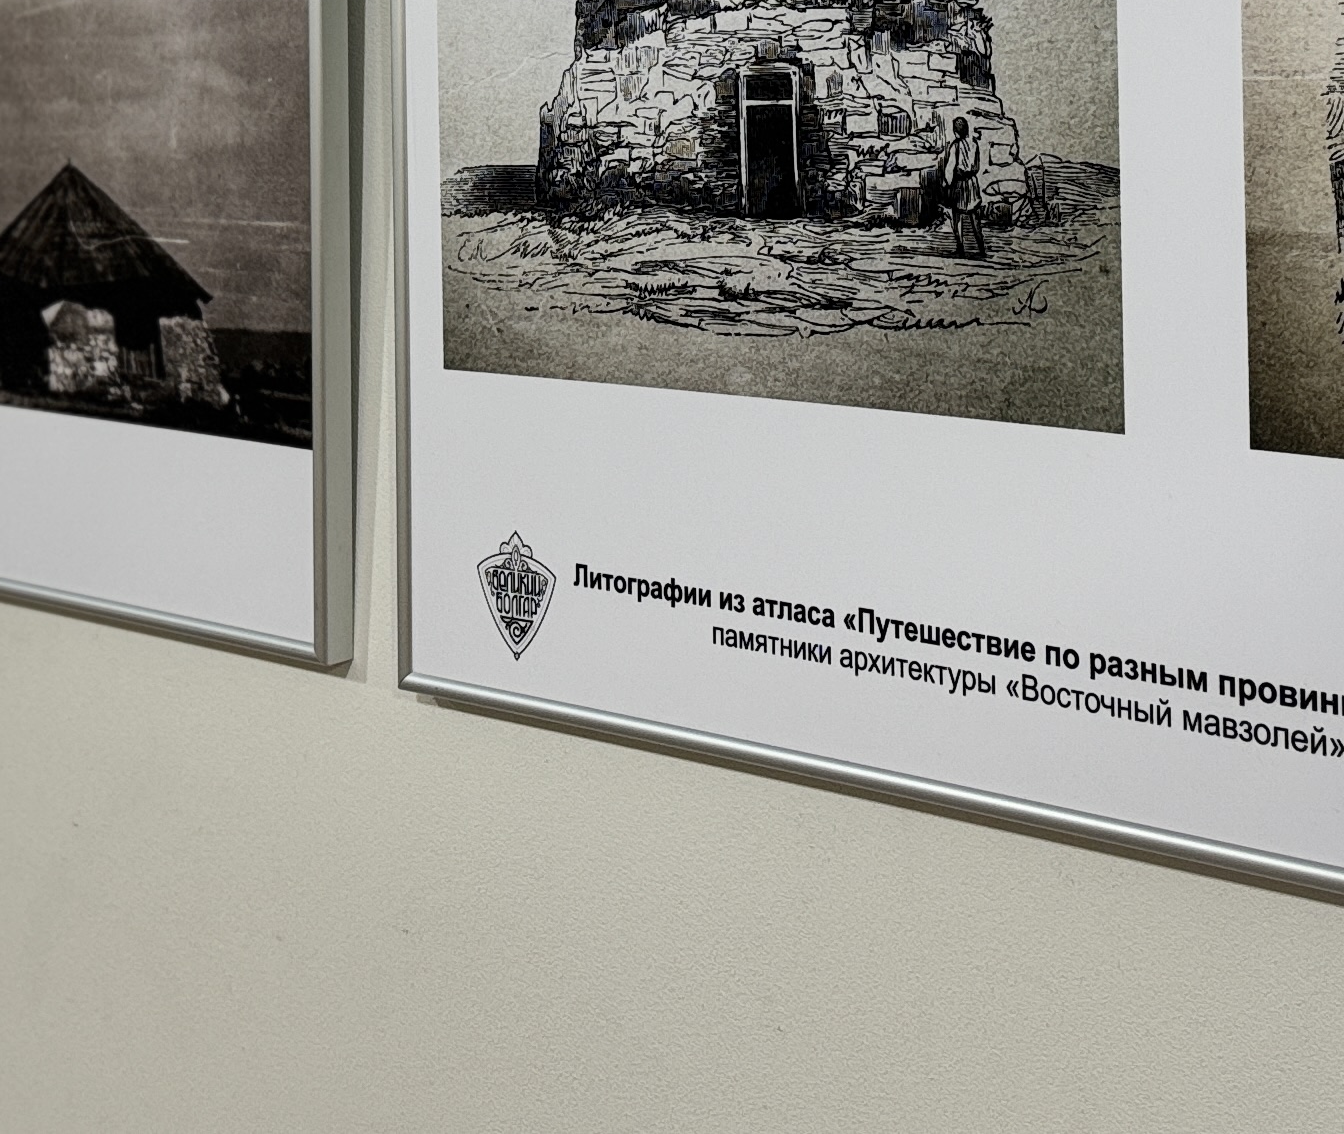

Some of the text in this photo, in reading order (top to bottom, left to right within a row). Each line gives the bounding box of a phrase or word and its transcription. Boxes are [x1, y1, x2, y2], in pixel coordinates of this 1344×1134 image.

[572, 562, 713, 609] Литографии
[719, 591, 746, 614] из
[752, 596, 836, 629] атласа
[843, 606, 1037, 663] «Путешествие
[1045, 644, 1080, 670] по
[1089, 652, 1208, 693] разным
[712, 625, 832, 666] памятники
[839, 648, 996, 697] архитектуры
[1005, 673, 1172, 729] «Восточный
